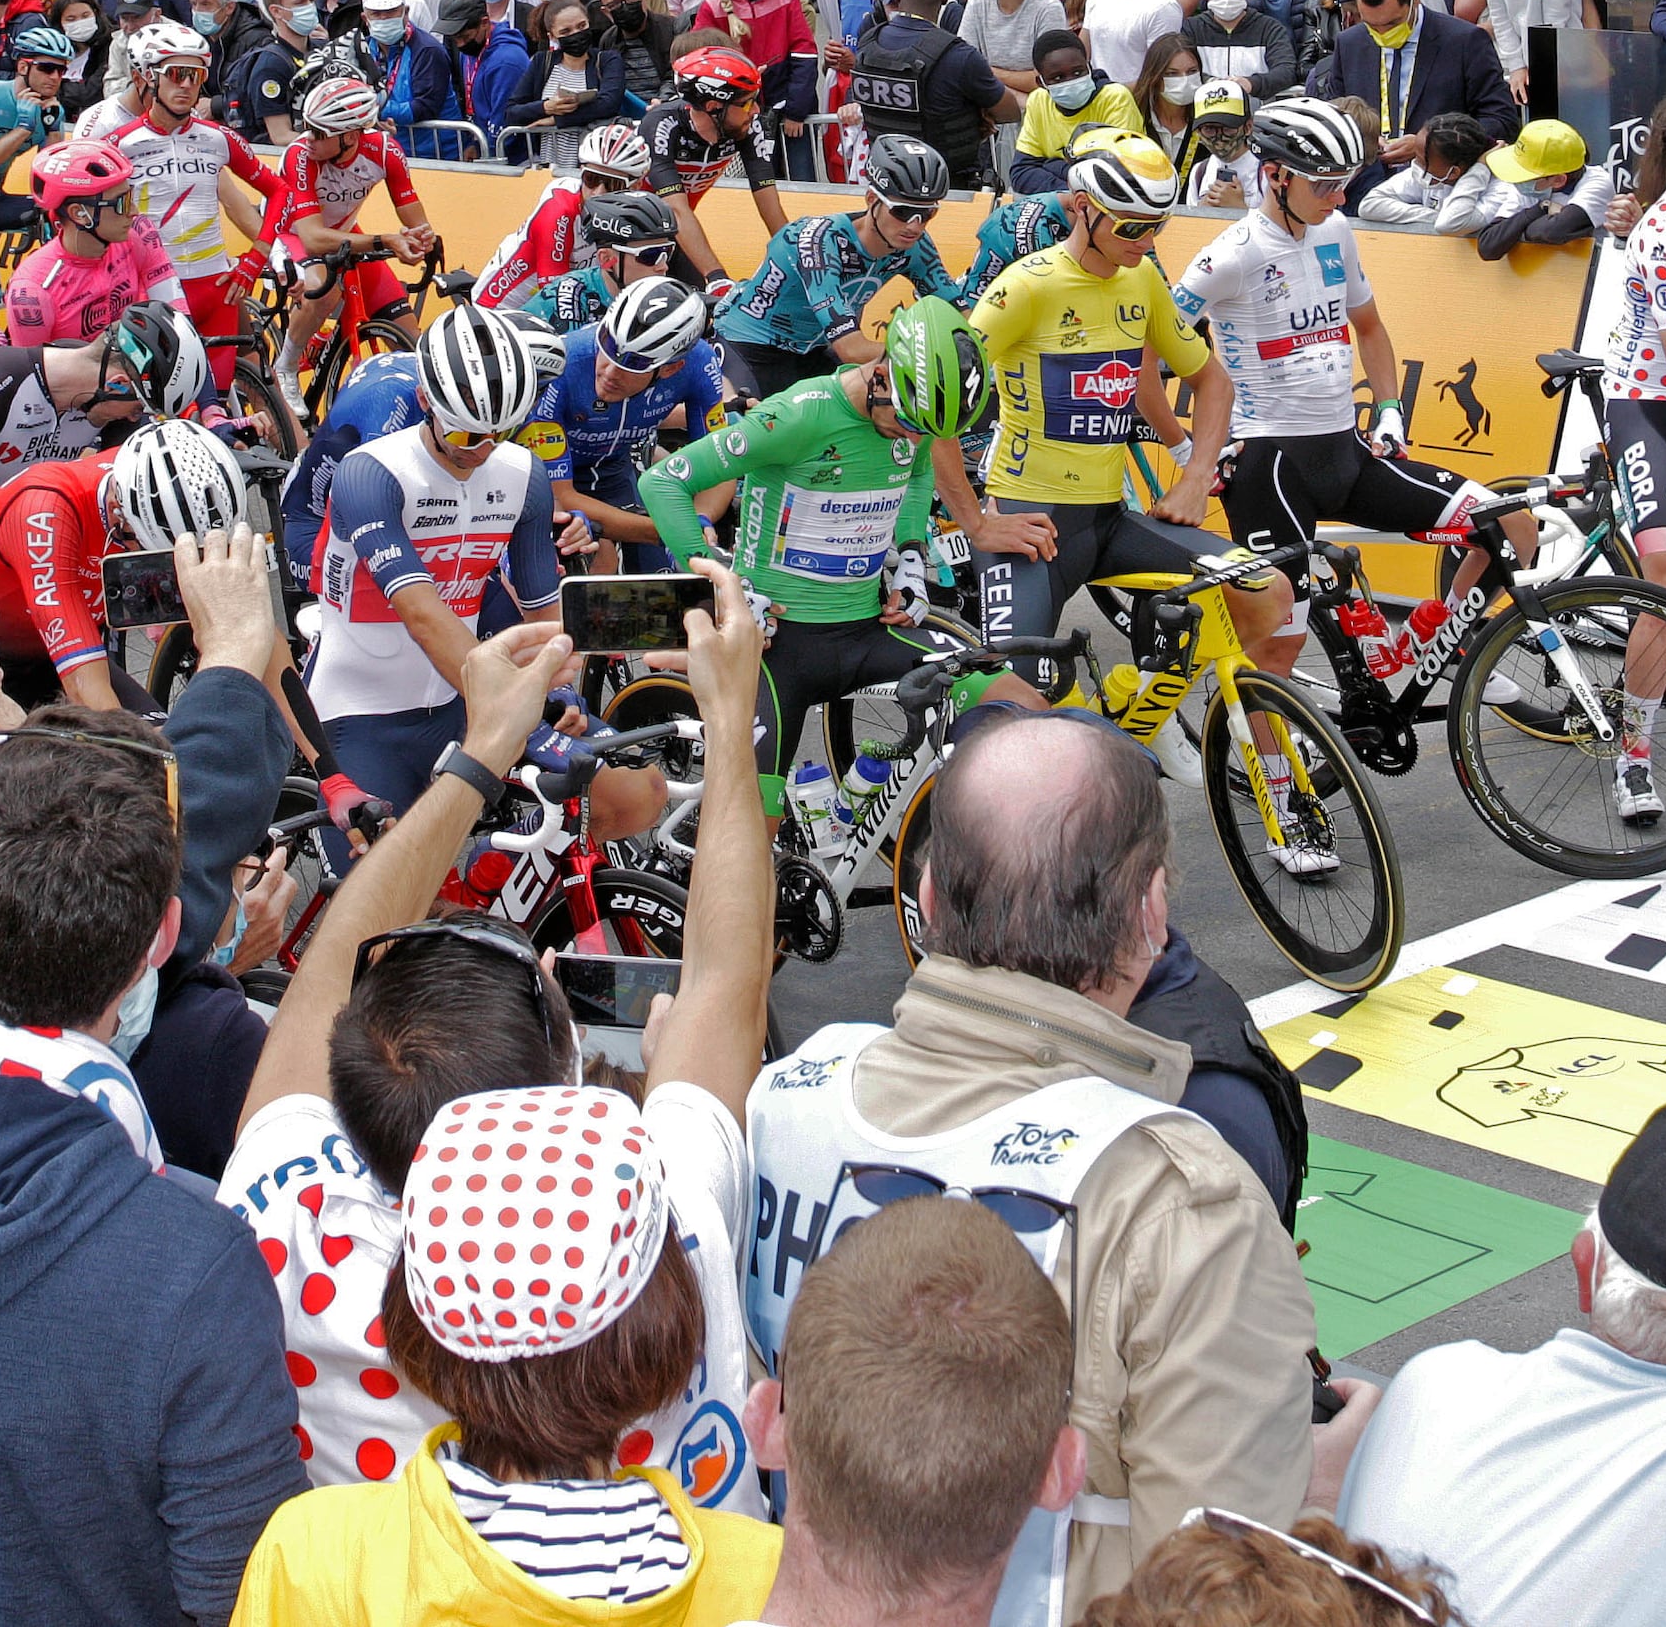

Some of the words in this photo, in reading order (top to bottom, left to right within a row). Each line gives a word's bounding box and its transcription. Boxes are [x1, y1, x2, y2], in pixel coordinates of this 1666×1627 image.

[853, 77, 912, 107] CRS
[1287, 130, 1321, 157] MET
[130, 157, 219, 181] Cofidis
[552, 215, 570, 262] Cofidis
[592, 213, 632, 238] bollé
[1290, 299, 1341, 330] UAE
[1623, 440, 1658, 523] BORA
[417, 498, 459, 508] SRAM
[1426, 530, 1463, 543] Emirates
[27, 512, 60, 607] ARKEA
[1213, 594, 1235, 648] CANYON
[1416, 586, 1486, 687] COLNAGO
[1575, 683, 1602, 722] COLNAGO
[1245, 743, 1273, 821] CANYON
[1557, 1054, 1617, 1074] LCL
